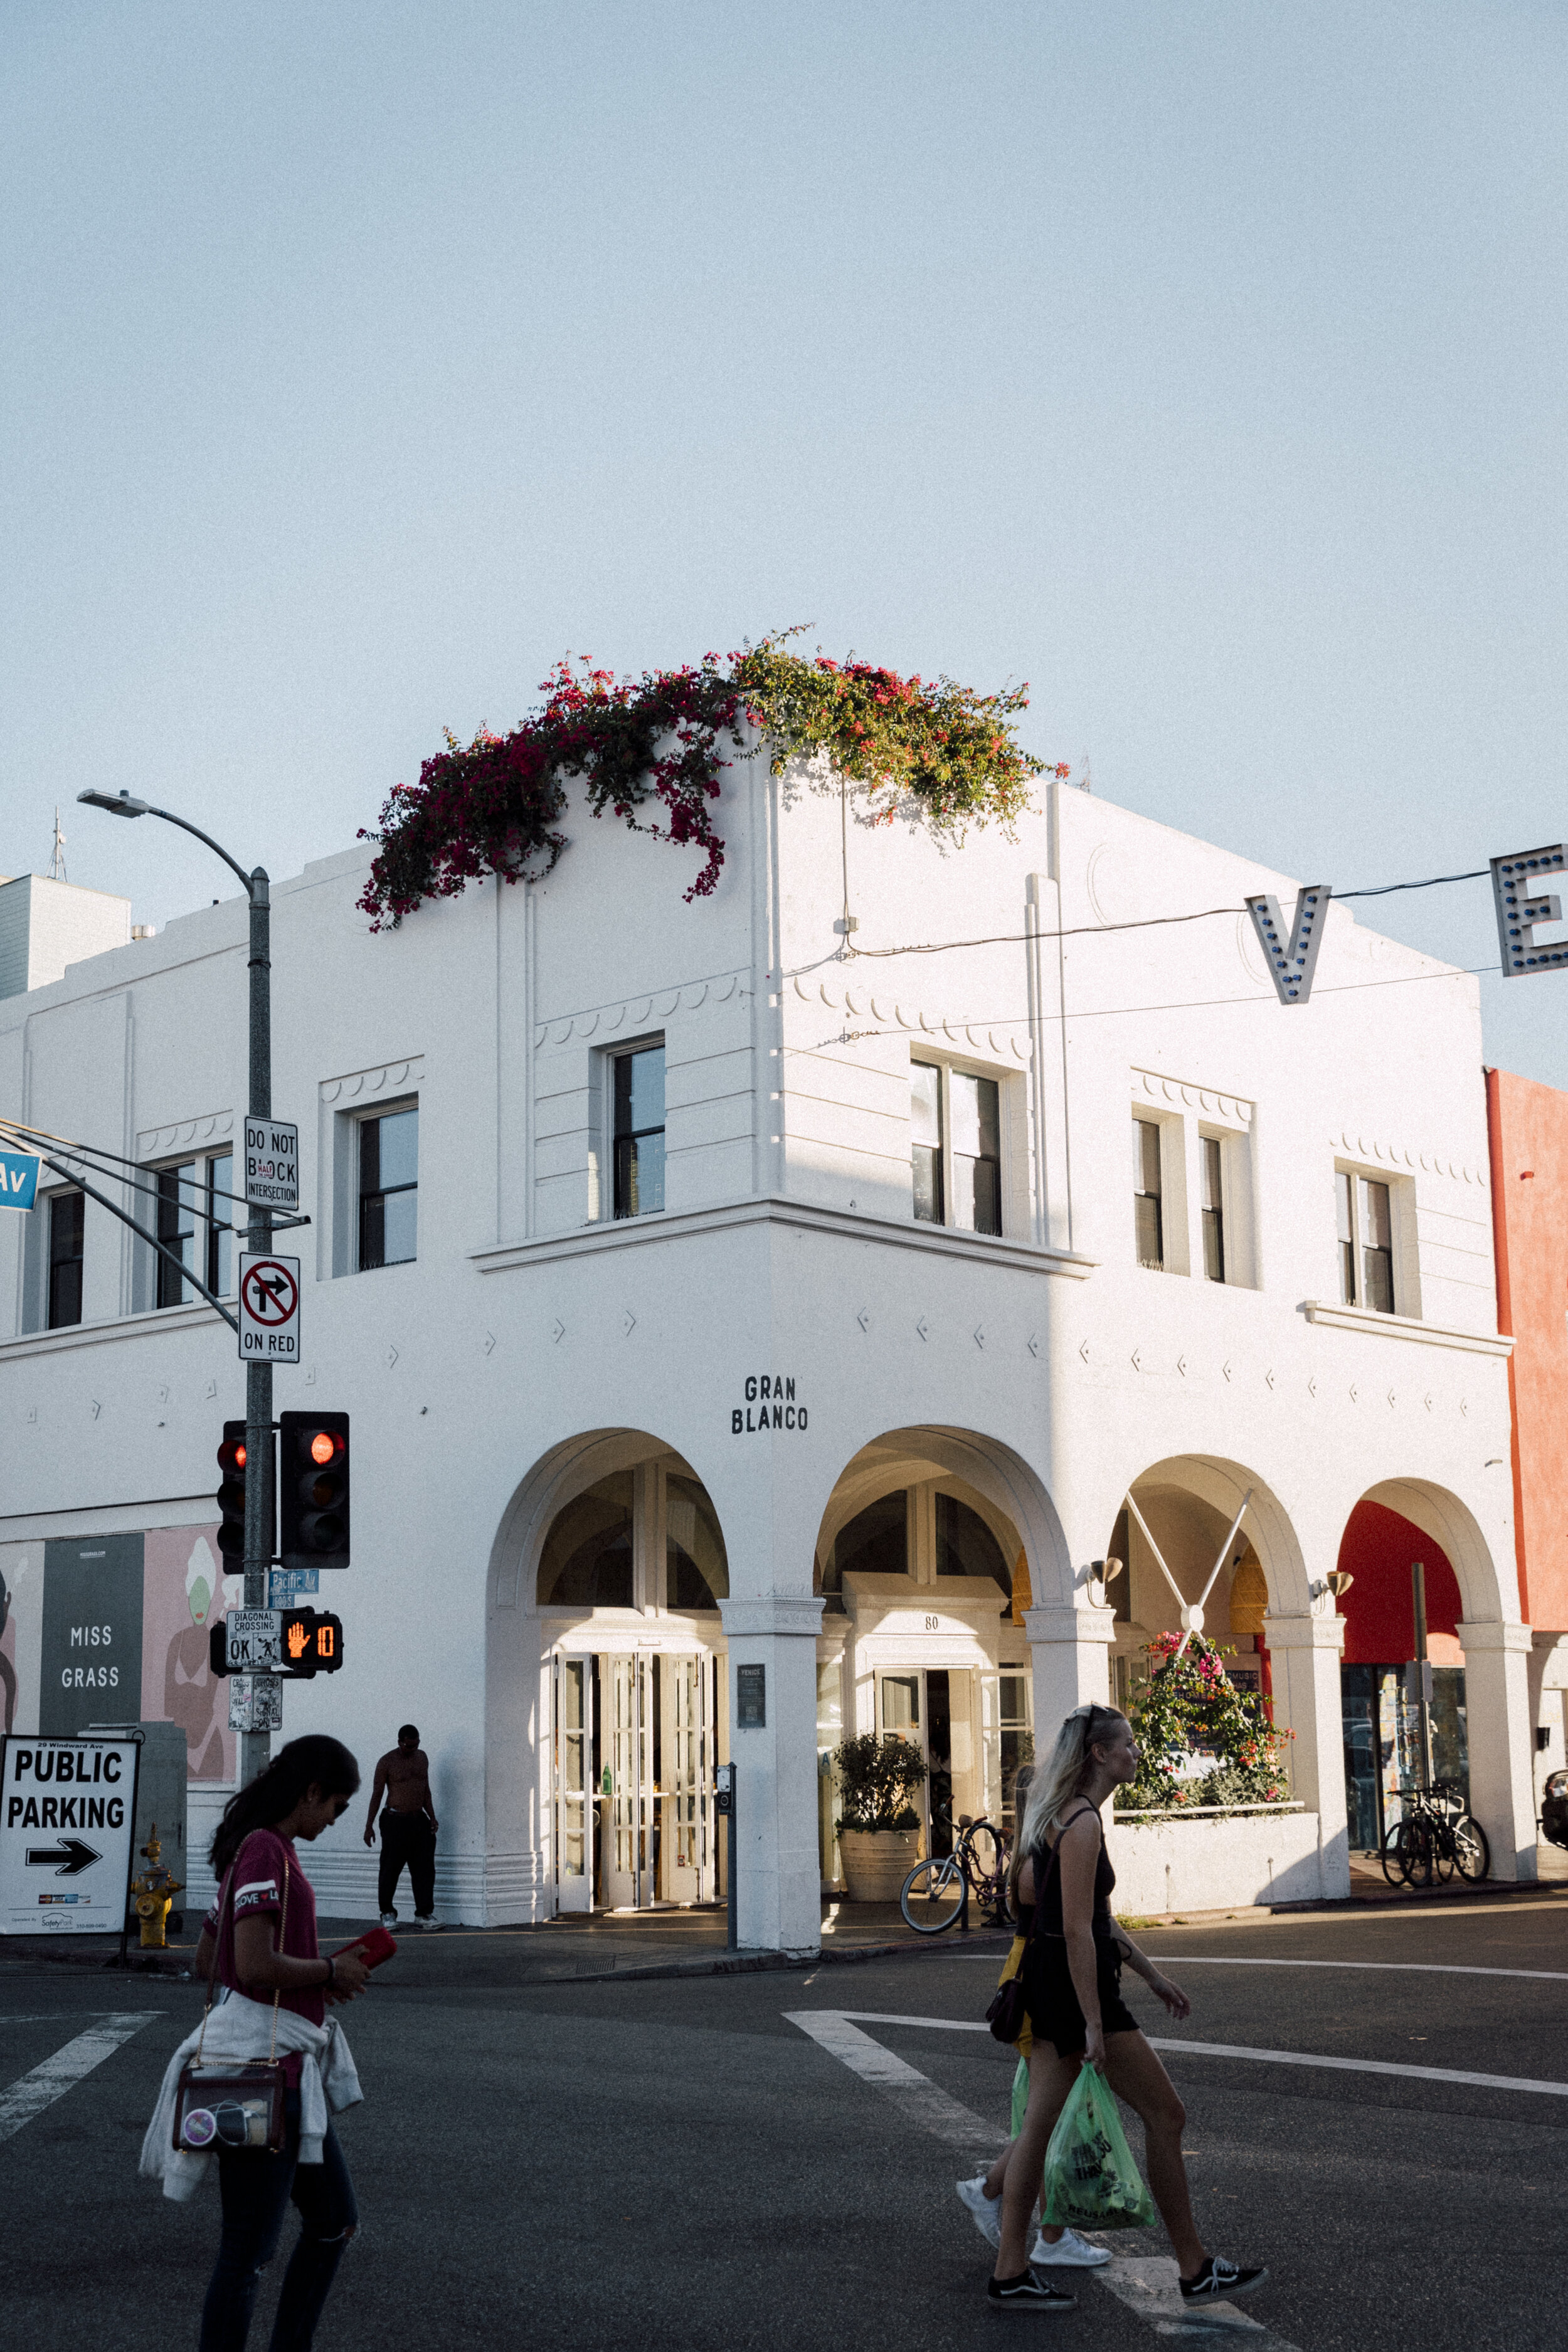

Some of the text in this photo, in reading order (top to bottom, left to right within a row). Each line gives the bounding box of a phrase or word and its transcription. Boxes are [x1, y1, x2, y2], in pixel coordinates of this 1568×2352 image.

[248, 1129, 295, 1155] DO NOT
[248, 1182, 296, 1202] INTERSECTION
[245, 1332, 295, 1352] ON RED
[745, 1375, 795, 1402] GRAN
[731, 1405, 808, 1434] BLANCO
[273, 1572, 302, 1589] Pacific
[235, 1612, 274, 1621] DIAGONAL
[235, 1621, 274, 1631] CROSSING
[925, 1616, 938, 1630] 80
[71, 1625, 112, 1646] MISS
[317, 1626, 334, 1656] 10
[230, 1640, 250, 1660] OK
[61, 1666, 119, 1688] GRASS
[741, 1668, 761, 1677] VENICE
[15, 1750, 122, 1783] PUBLIC
[8, 1796, 124, 1829] PARKING
